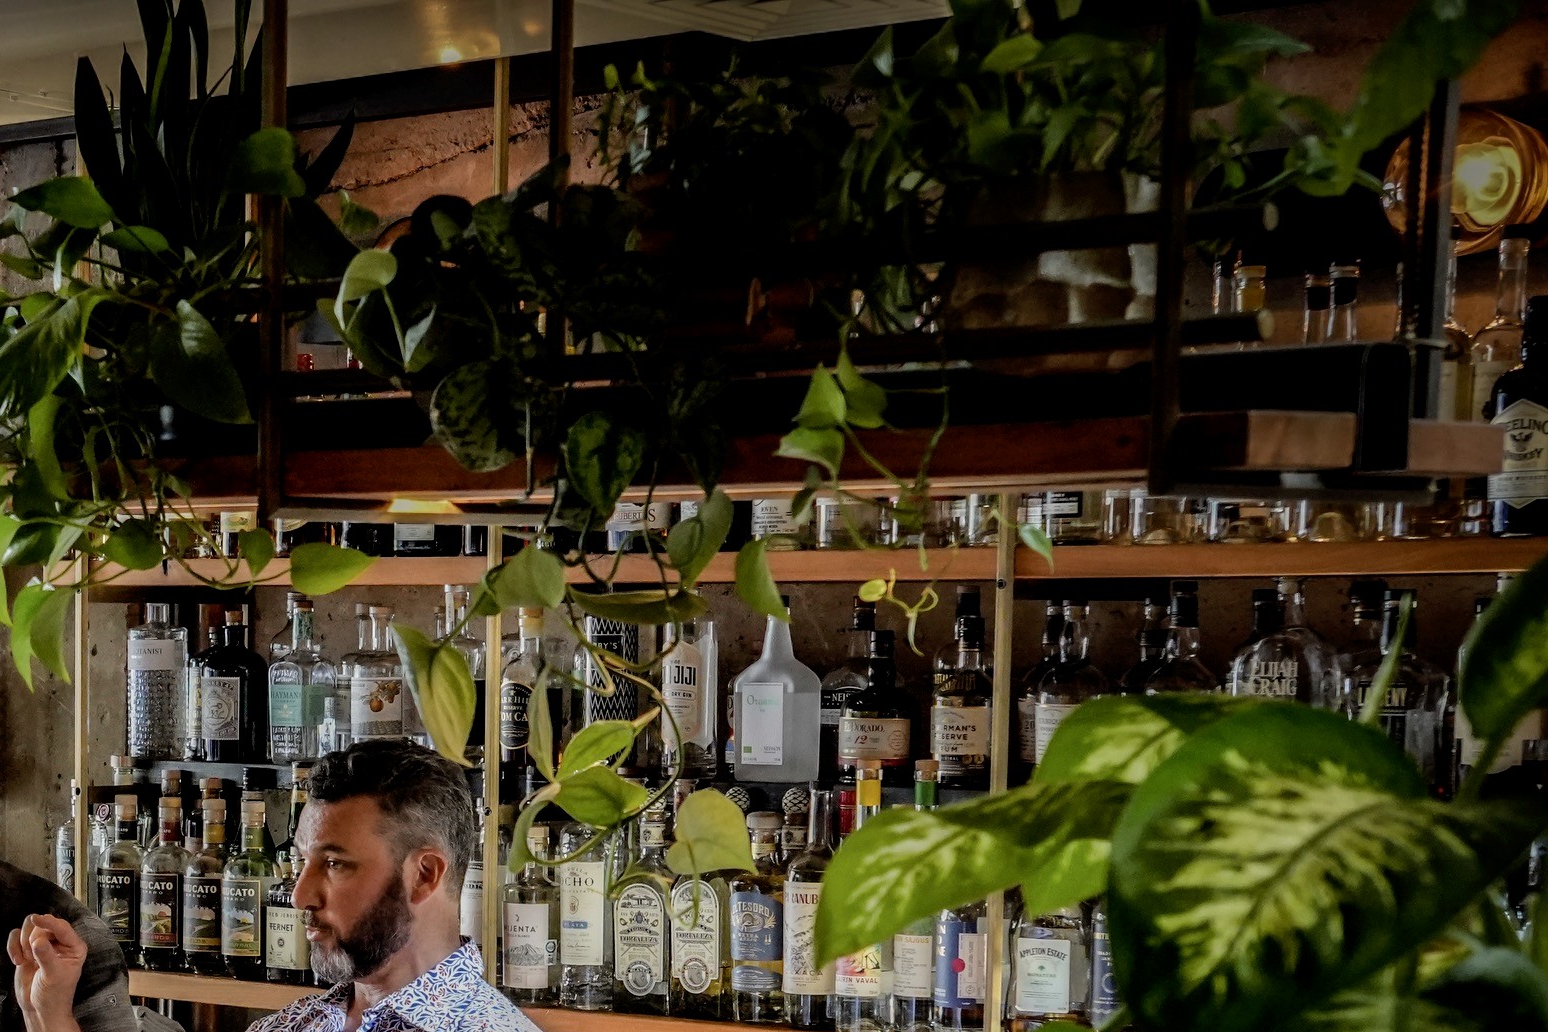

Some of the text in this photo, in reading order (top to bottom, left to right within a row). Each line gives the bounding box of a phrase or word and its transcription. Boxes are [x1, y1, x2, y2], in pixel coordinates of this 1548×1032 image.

[1252, 660, 1298, 678] ELIJAH
[674, 665, 697, 687] JIJI
[1252, 678, 1298, 696] CRAIG
[514, 712, 529, 722] CA
[854, 735, 868, 745] 12
[934, 733, 968, 741] RSERVE
[97, 875, 131, 885] RUCATO
[269, 922, 294, 933] FERNET
[1019, 947, 1068, 961] APPLETON ESTATE
[855, 976, 878, 984] VAVAL
